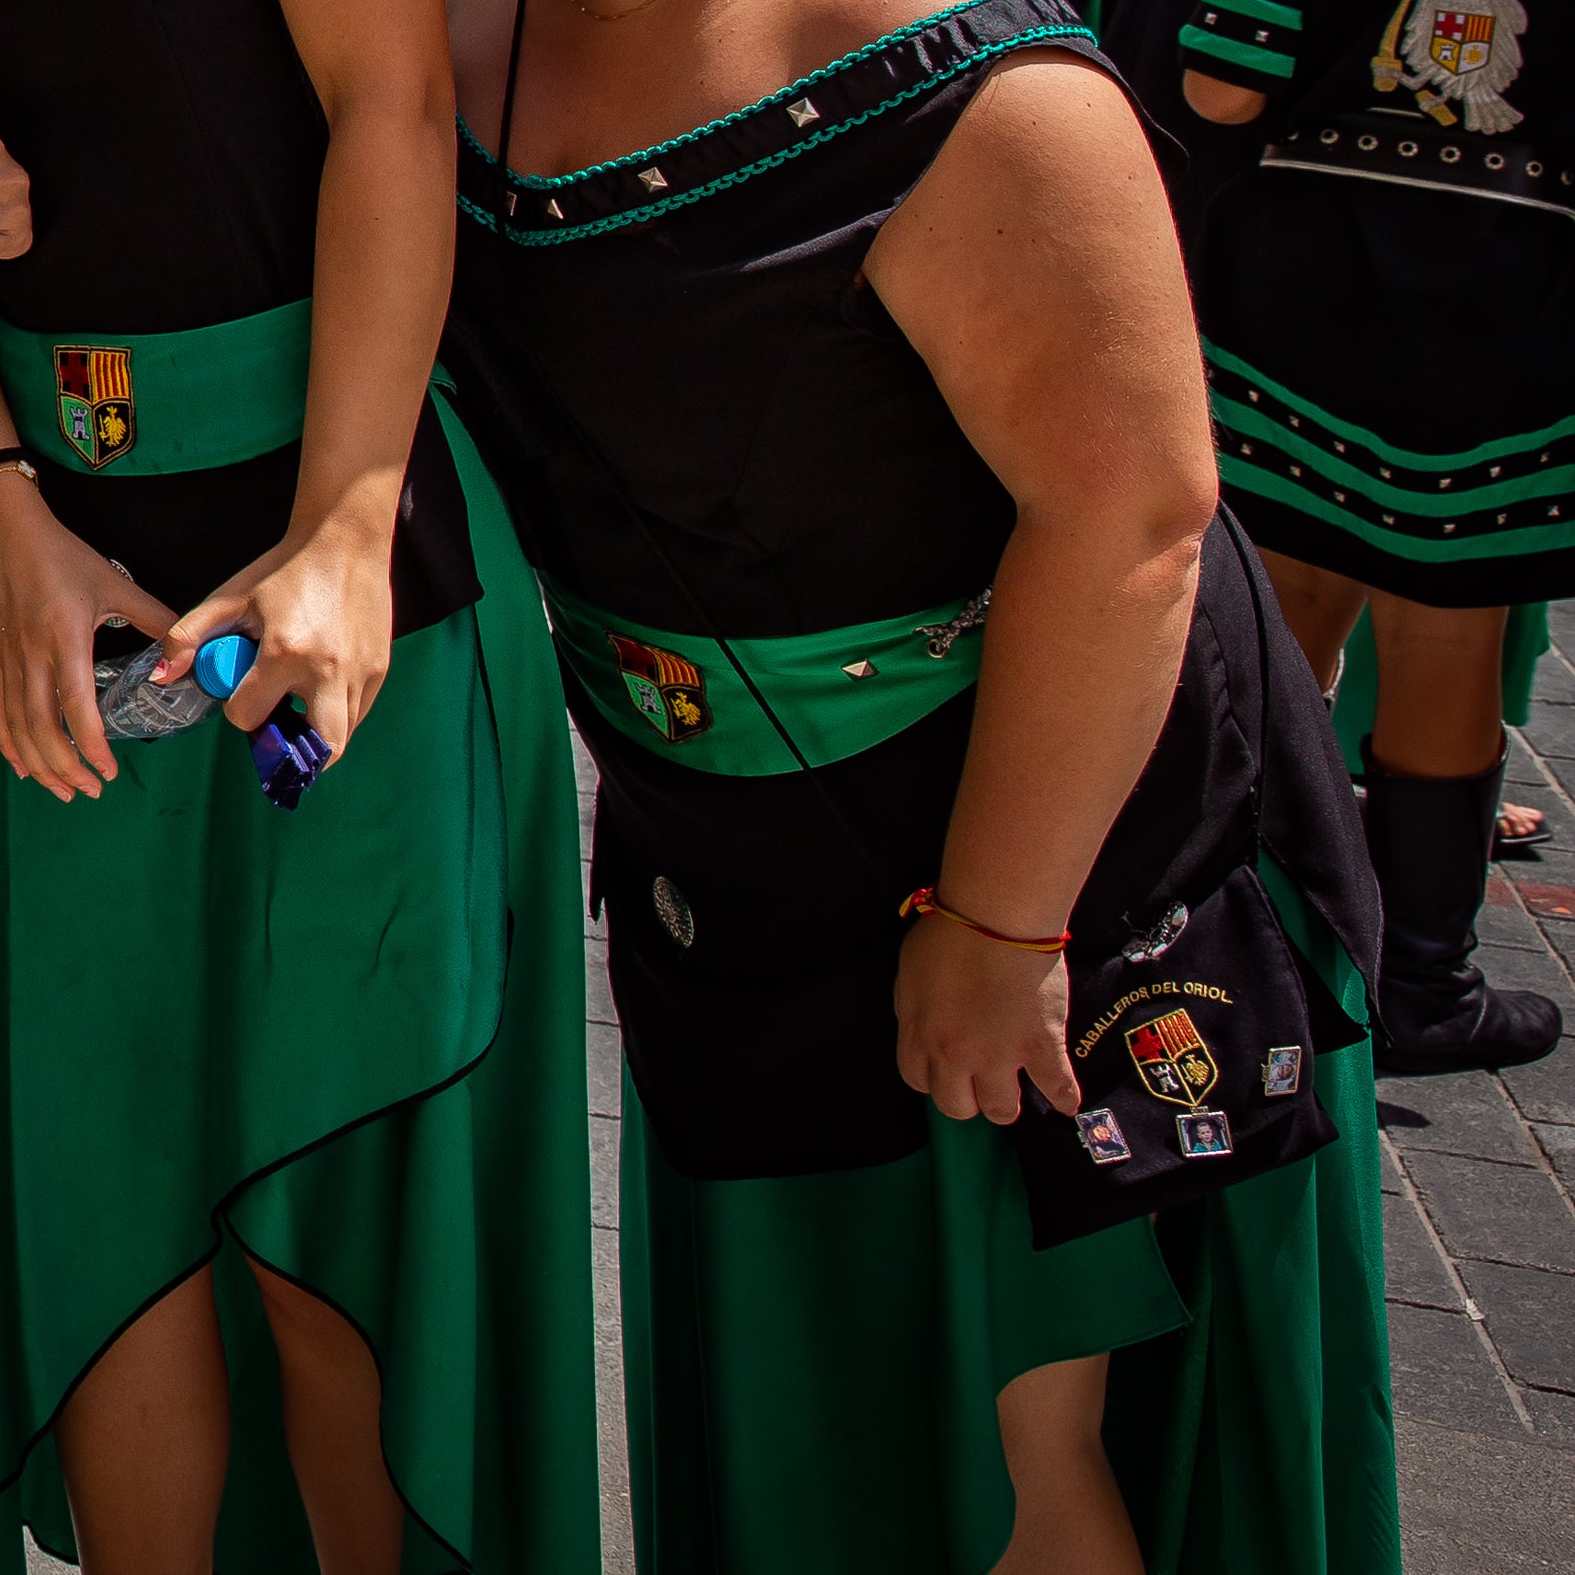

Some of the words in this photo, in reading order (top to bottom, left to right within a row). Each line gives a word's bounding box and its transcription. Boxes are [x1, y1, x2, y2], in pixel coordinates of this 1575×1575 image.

[1074, 986, 1152, 1058] CABALLEROS
[1151, 981, 1181, 996] DEL
[1183, 981, 1234, 1005] ORIOL
